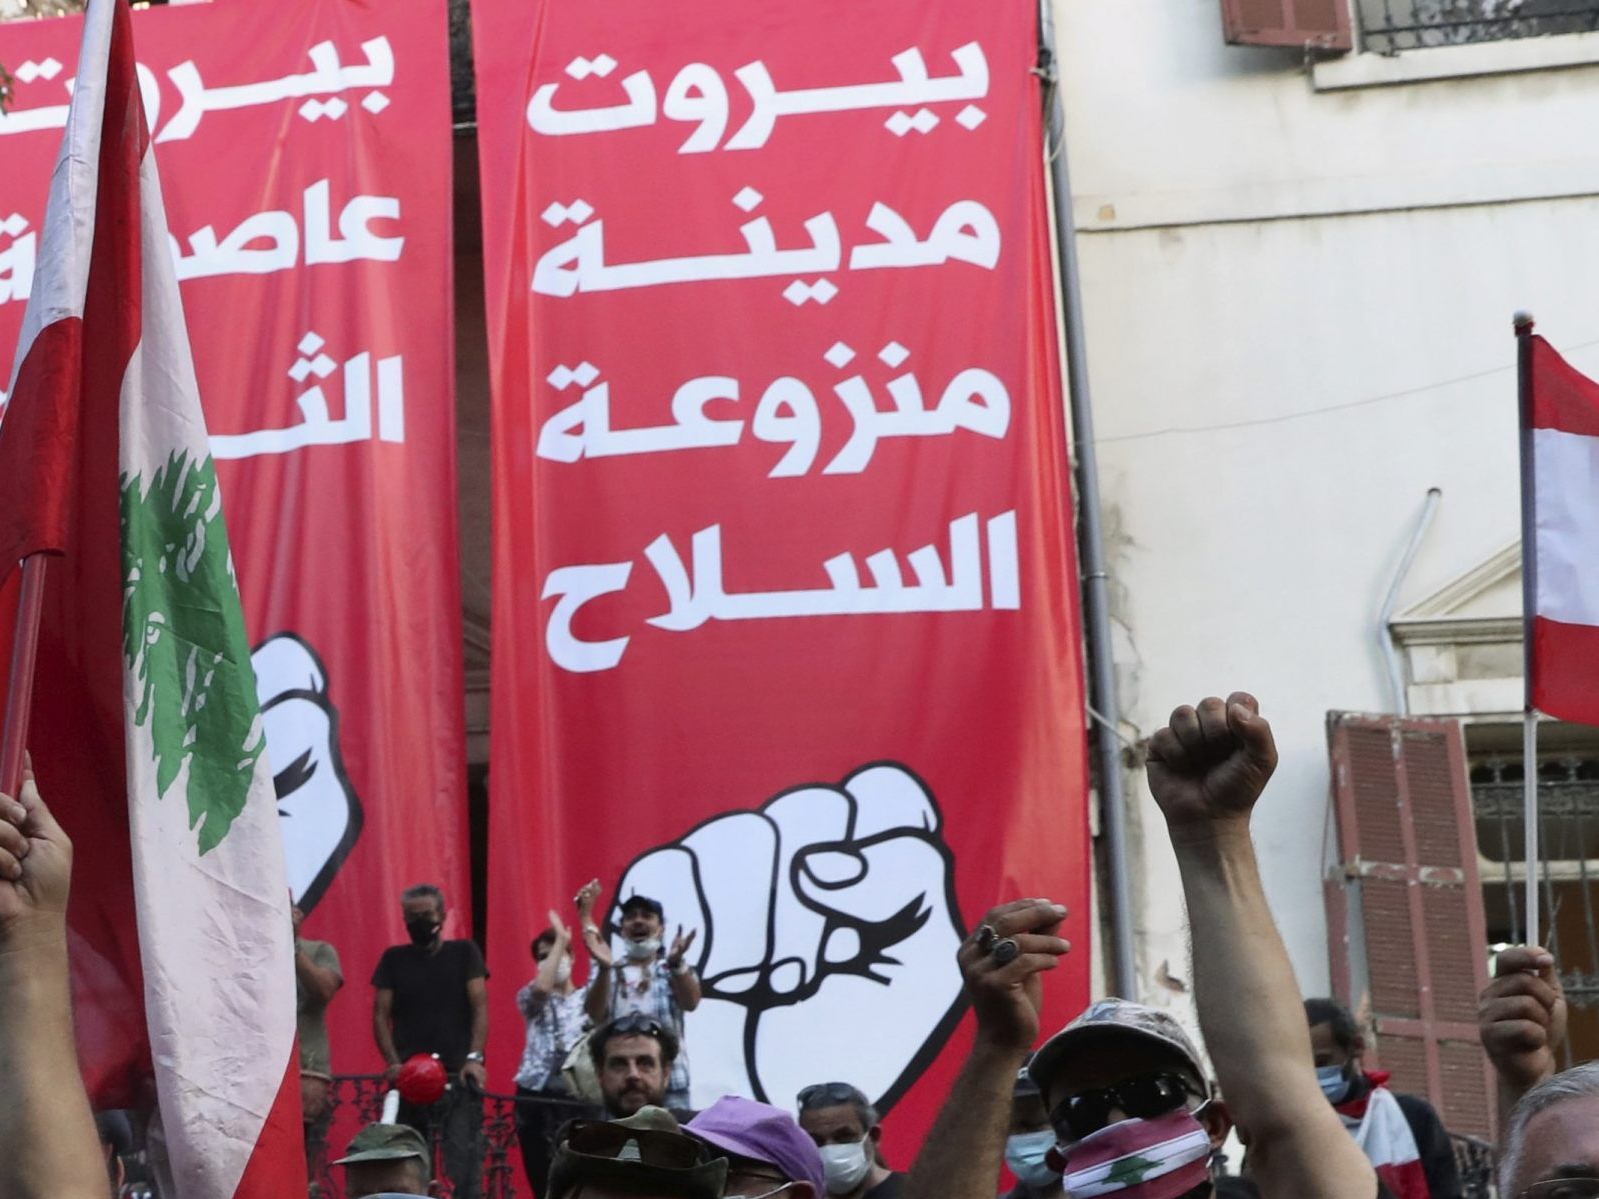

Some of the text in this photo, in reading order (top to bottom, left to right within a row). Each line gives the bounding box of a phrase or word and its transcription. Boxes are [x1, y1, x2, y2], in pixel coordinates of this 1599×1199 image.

[525, 41, 990, 154] بيروت
[530, 186, 1001, 307] مدينة
[535, 341, 1011, 478] منزوعة
[540, 509, 1021, 673] السلاح
